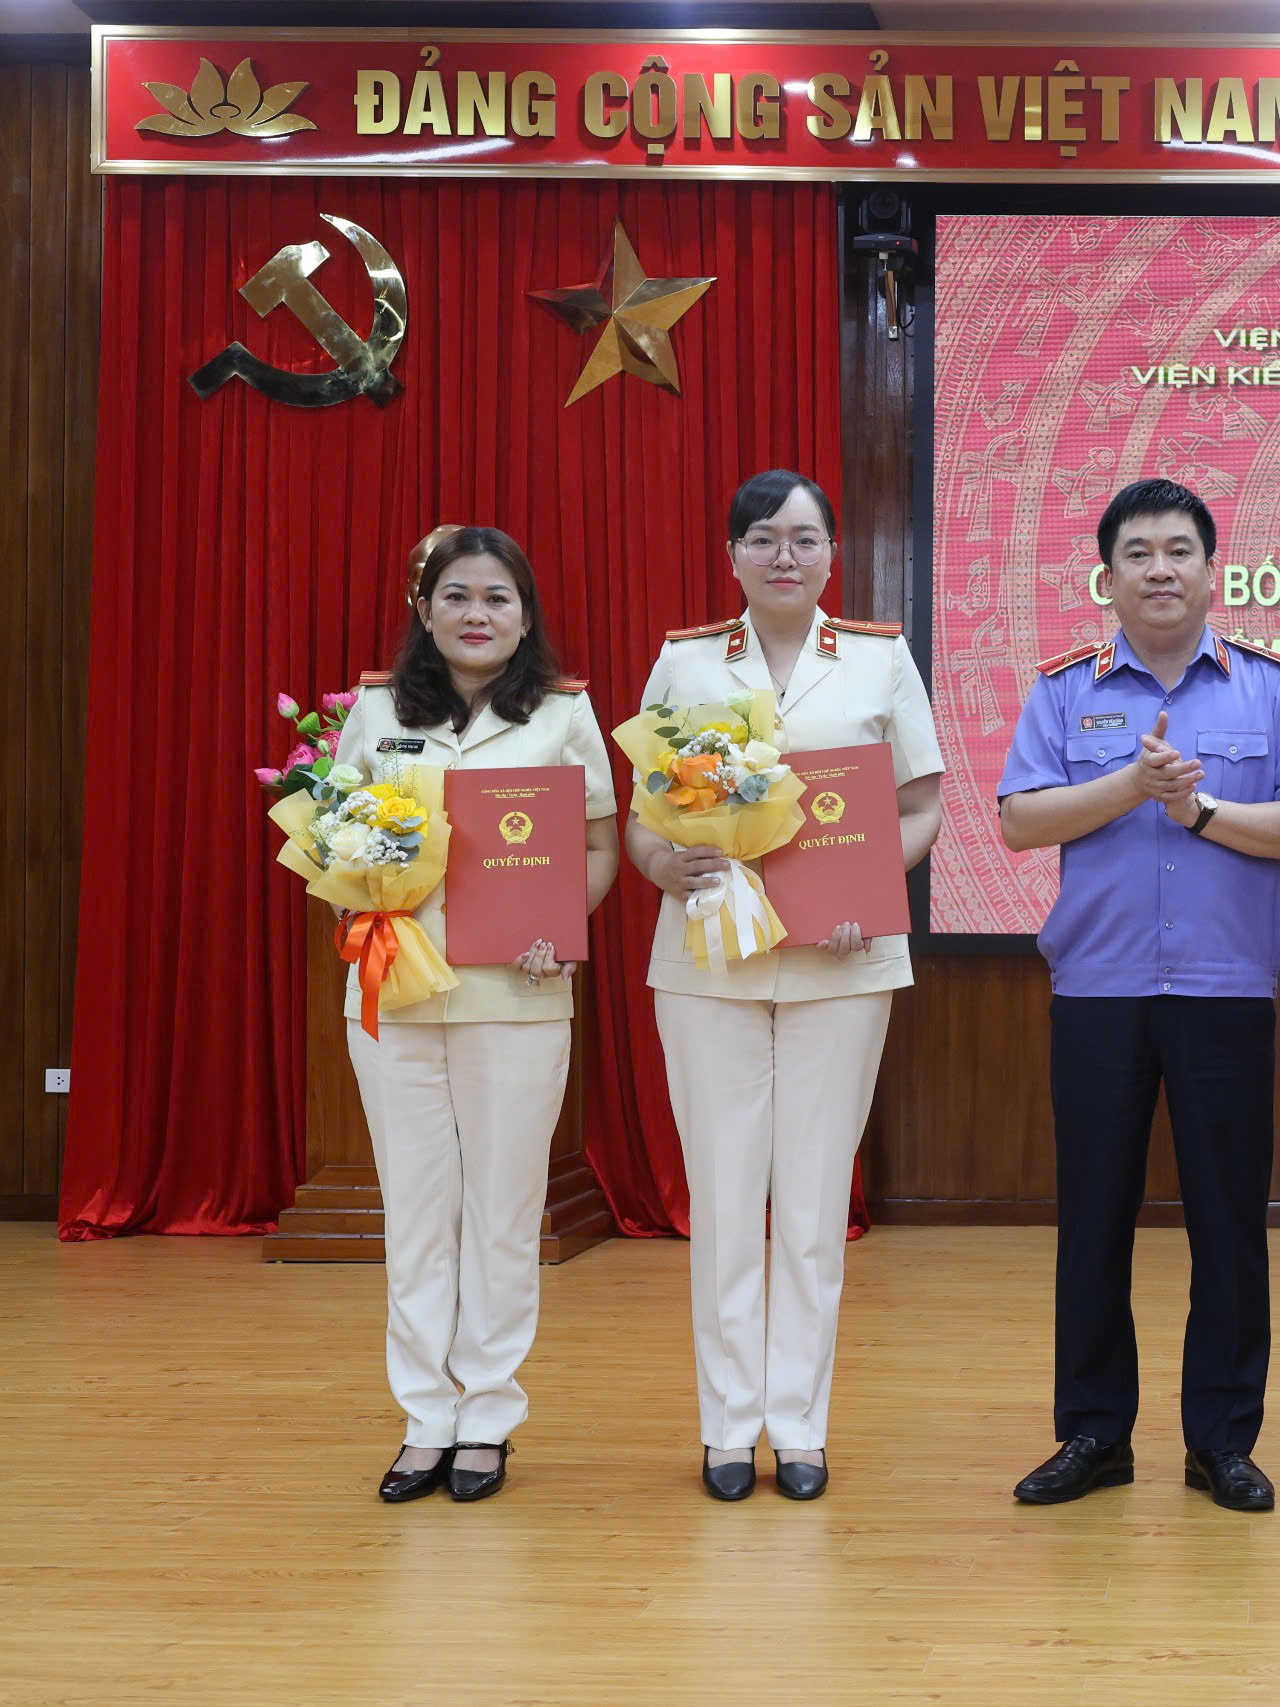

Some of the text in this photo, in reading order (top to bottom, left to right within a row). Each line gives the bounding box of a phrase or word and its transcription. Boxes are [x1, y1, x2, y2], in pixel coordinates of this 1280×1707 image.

[354, 45, 556, 138] ĐẢNG
[584, 54, 780, 155] CỘNG
[806, 49, 953, 141] SẢN
[977, 59, 1131, 157] VIỆT
[1131, 363, 1215, 388] VIỆN
[799, 833, 866, 850] QUYẾT ĐỊNH
[483, 854, 551, 868] QUYẾT ĐỊNH
